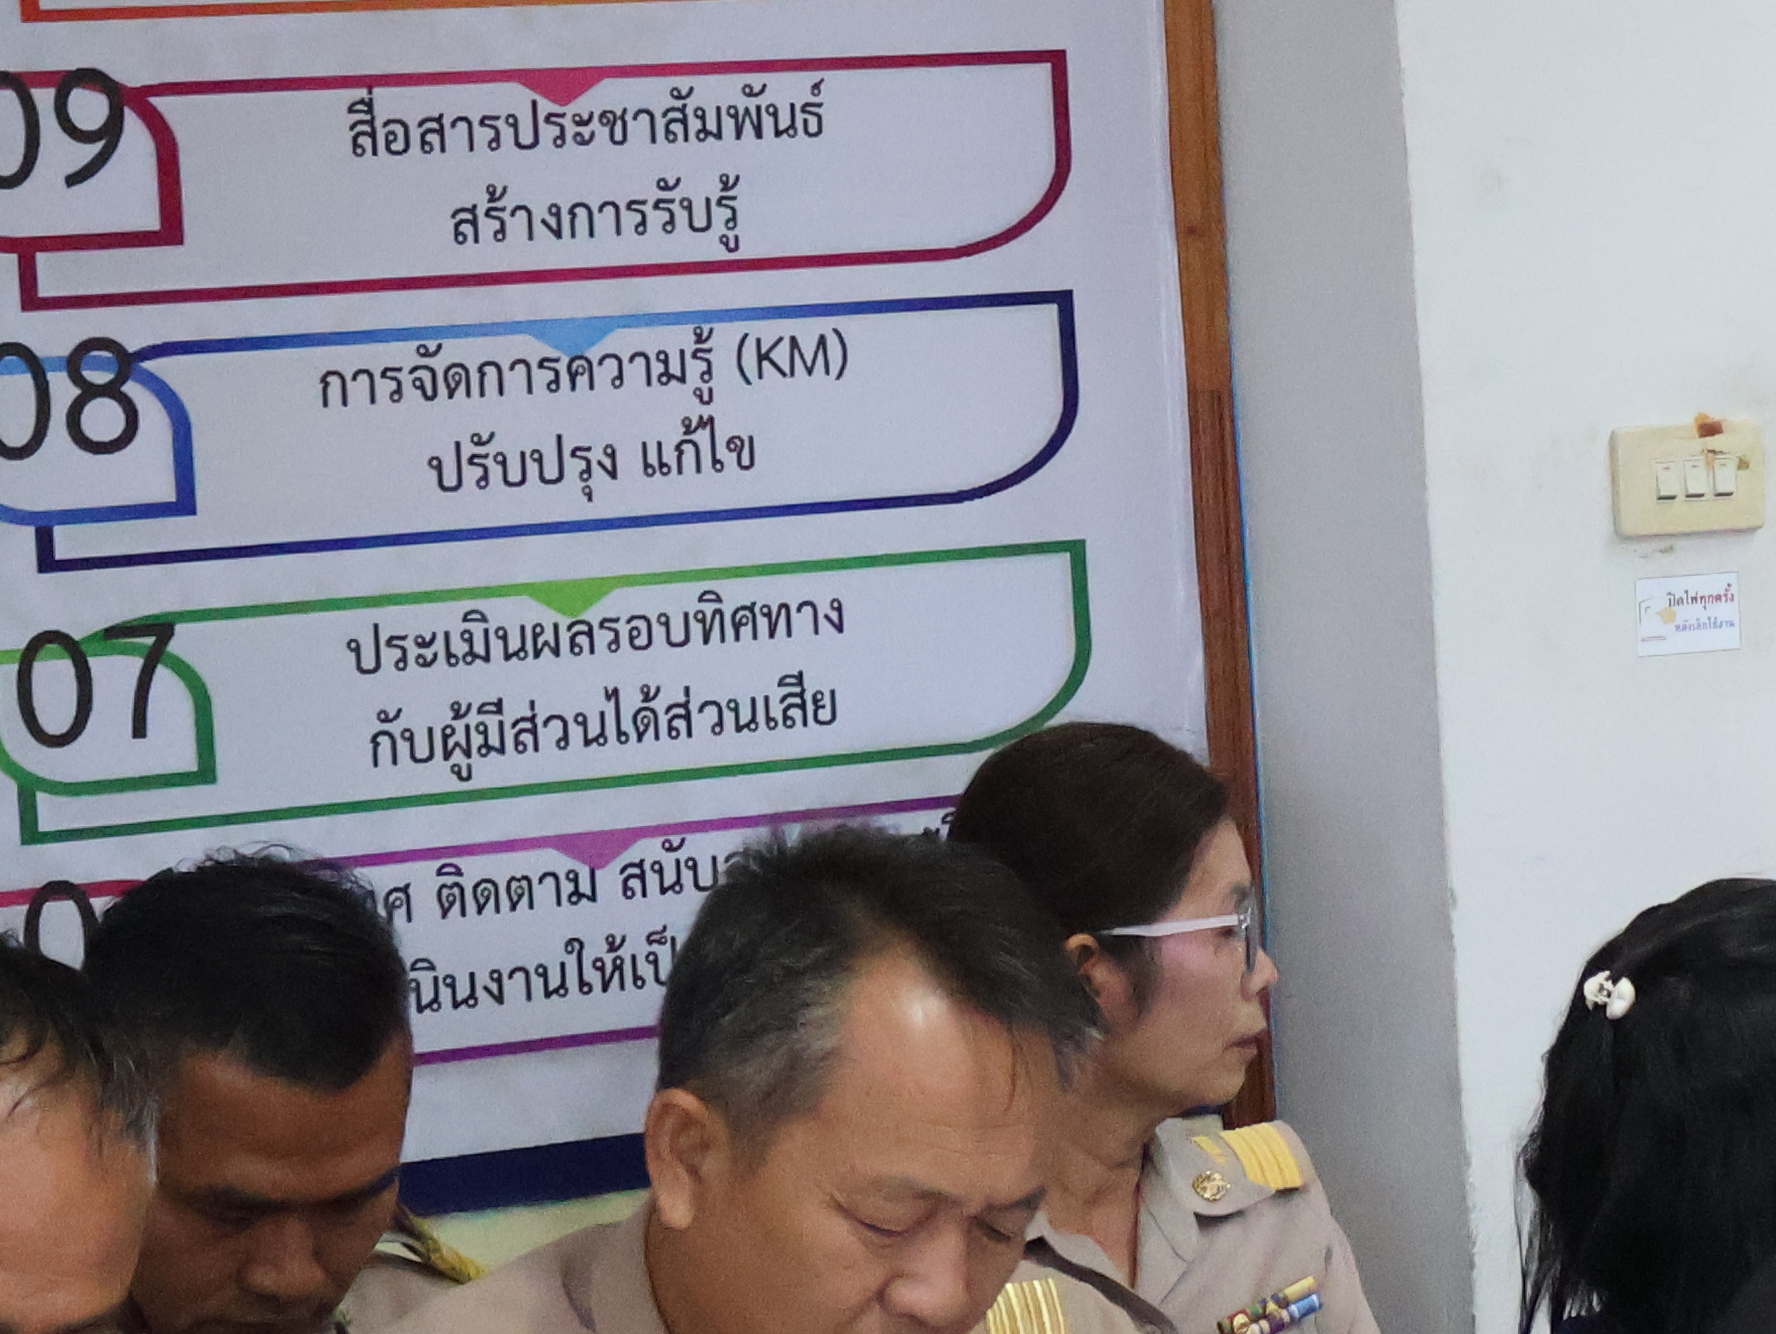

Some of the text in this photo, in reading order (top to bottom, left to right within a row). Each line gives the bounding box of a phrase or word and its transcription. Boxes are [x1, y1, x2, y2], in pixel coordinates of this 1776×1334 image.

[347, 78, 826, 159] สื่อสารประชาสัมพันธ์
[450, 175, 745, 255] สร้างการรับรู้
[319, 326, 850, 411] การจัดการความรู้ (KM)
[427, 417, 757, 506] ปรับปรุง แก้ไข
[347, 591, 848, 677] ประเมินผลรอบทิศทาง
[16, 622, 175, 749] 07
[369, 674, 840, 784] กับผู้มีส่วนได้ส่วนเสีย
[436, 862, 597, 920] ติดตาม
[619, 837, 742, 900] สนับ
